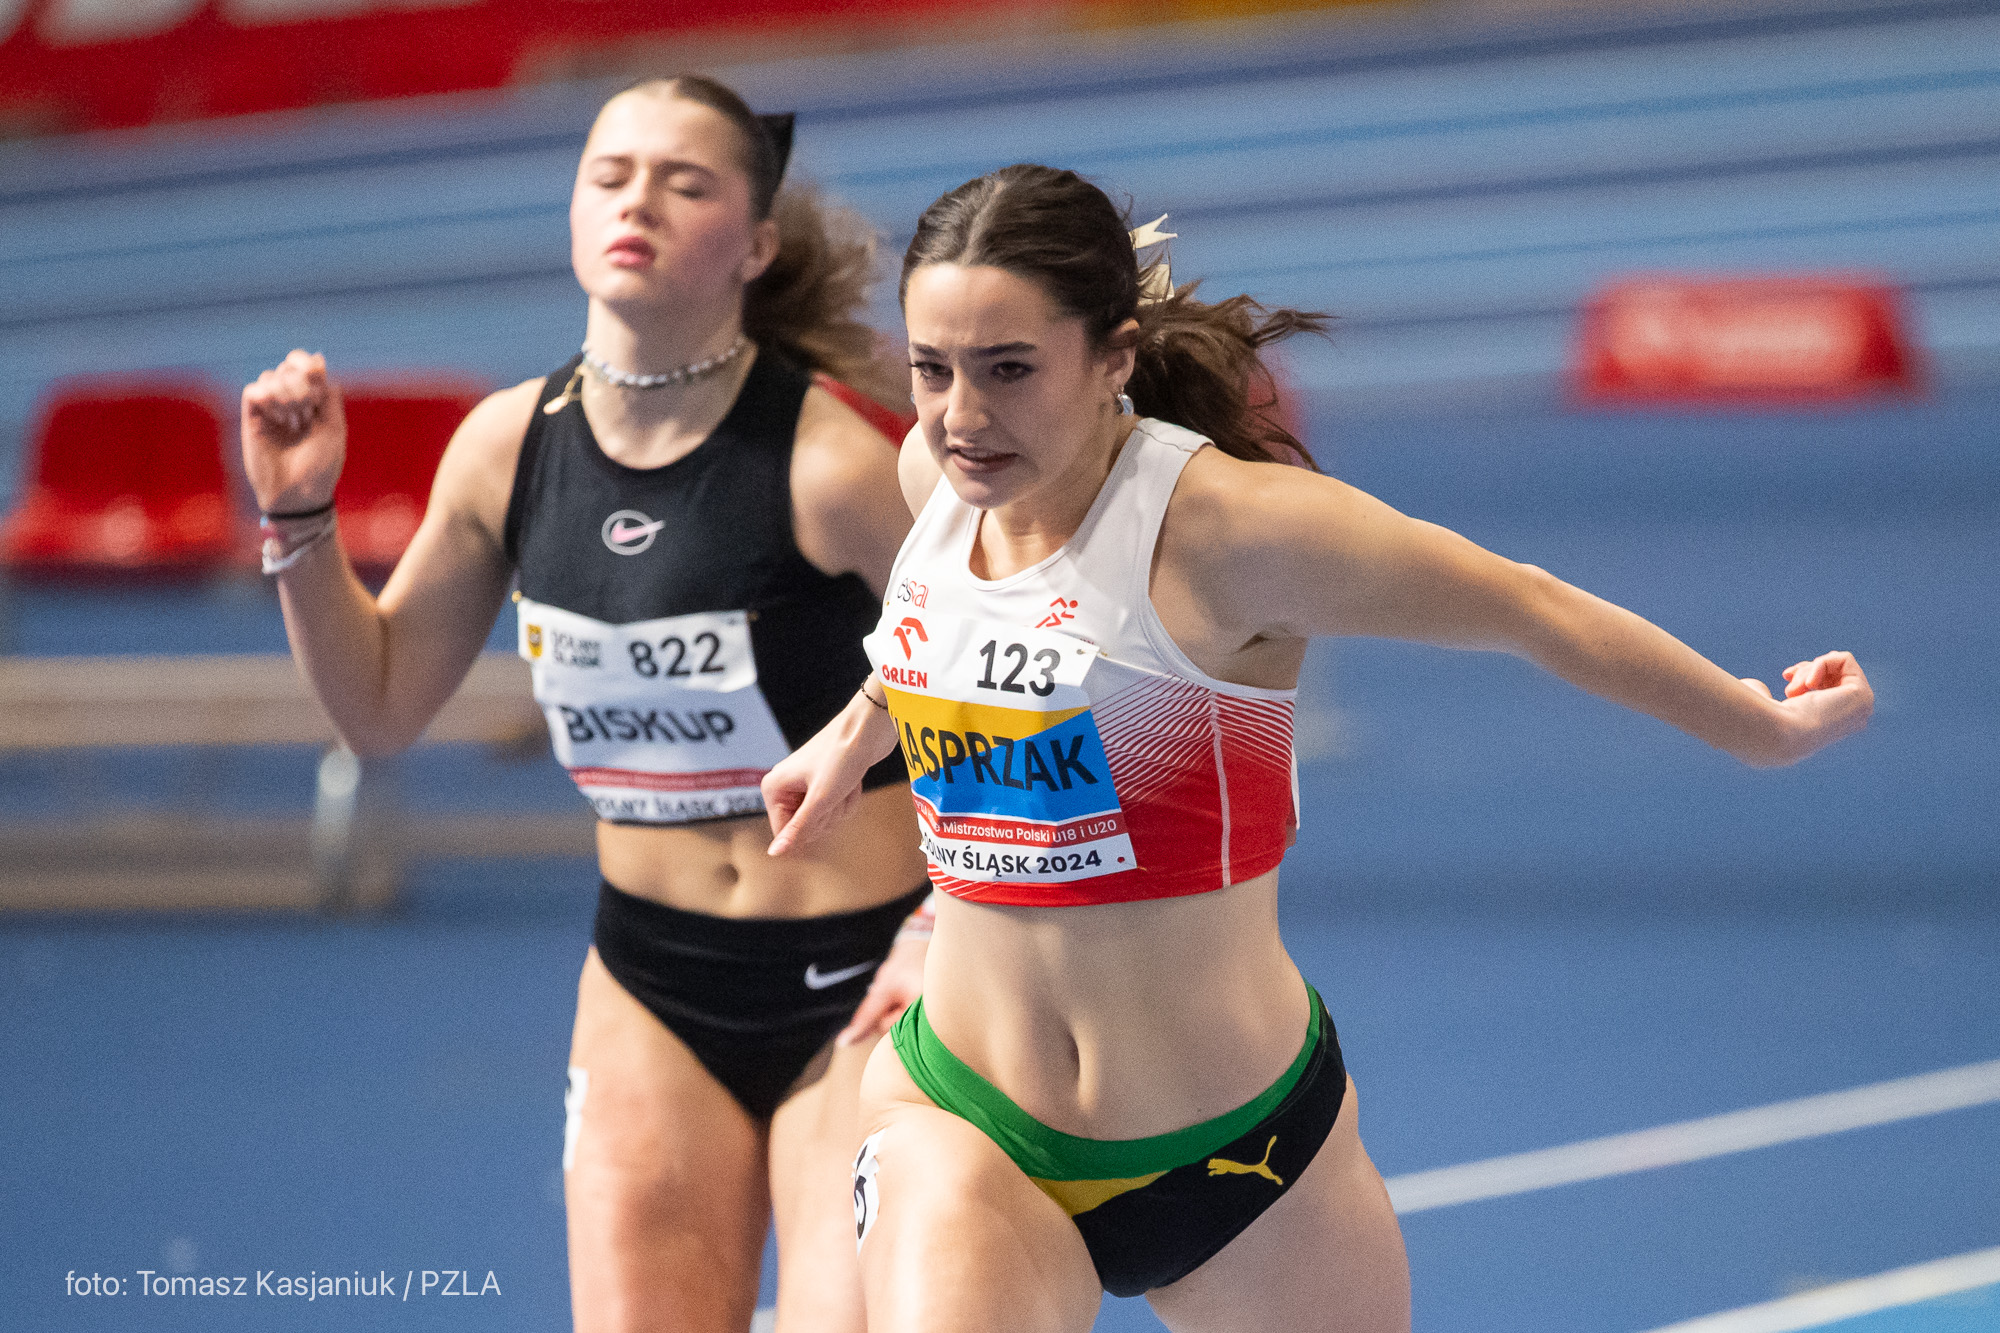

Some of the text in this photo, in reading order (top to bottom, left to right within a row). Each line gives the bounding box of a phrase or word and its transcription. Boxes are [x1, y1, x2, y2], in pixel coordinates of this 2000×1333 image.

[628, 631, 725, 678] 822
[976, 639, 1061, 697] 123
[882, 664, 928, 689] ORLEN
[559, 704, 735, 746] BISKUP
[943, 819, 1117, 843] Mistrzostwa Polski U18 i U20
[962, 844, 1032, 877] ŚLĄSK
[1036, 849, 1102, 874] 2024
